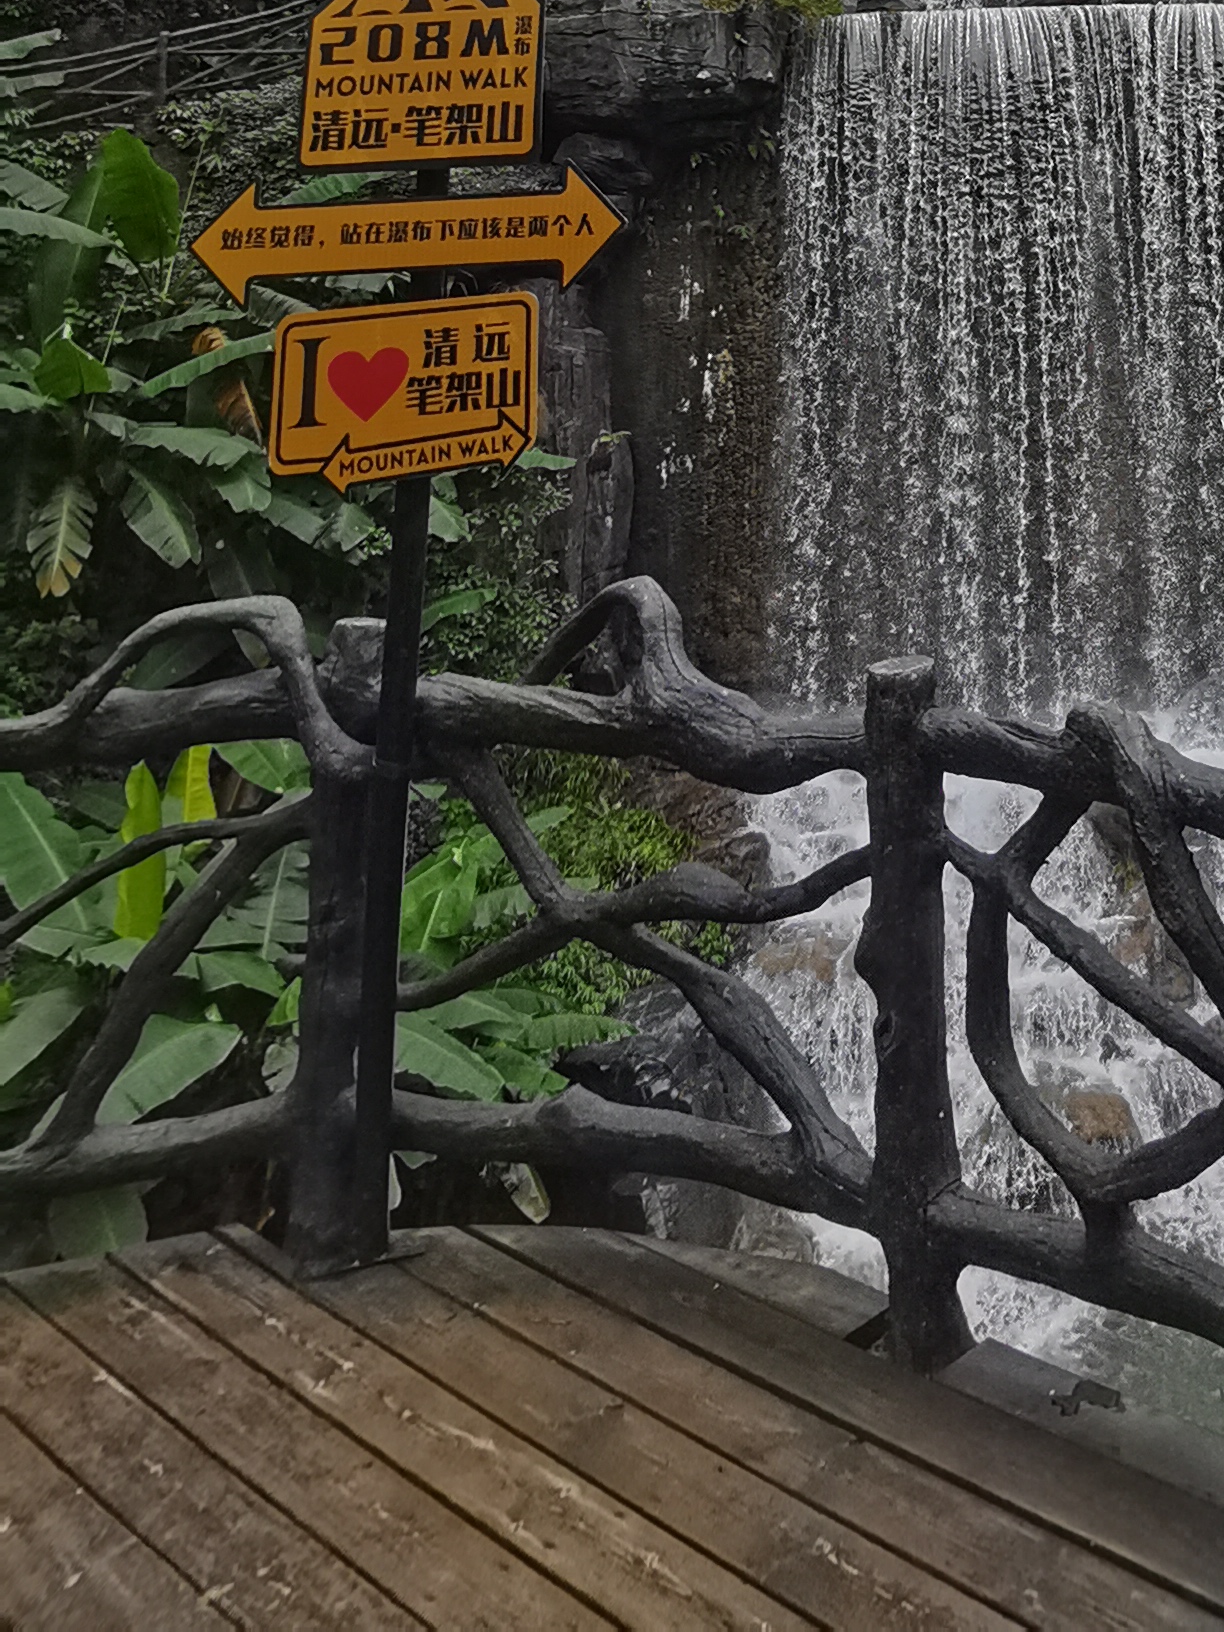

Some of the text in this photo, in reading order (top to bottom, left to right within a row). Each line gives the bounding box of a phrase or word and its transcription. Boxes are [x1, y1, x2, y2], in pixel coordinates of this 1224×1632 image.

[319, 17, 511, 66] 208M
[513, 15, 534, 57] 瀑布
[314, 65, 529, 99] MOUNTAIN WALK
[286, 335, 332, 430] I
[405, 367, 522, 417] 笔架山
[338, 433, 515, 478] MOUNTAIN WALK
